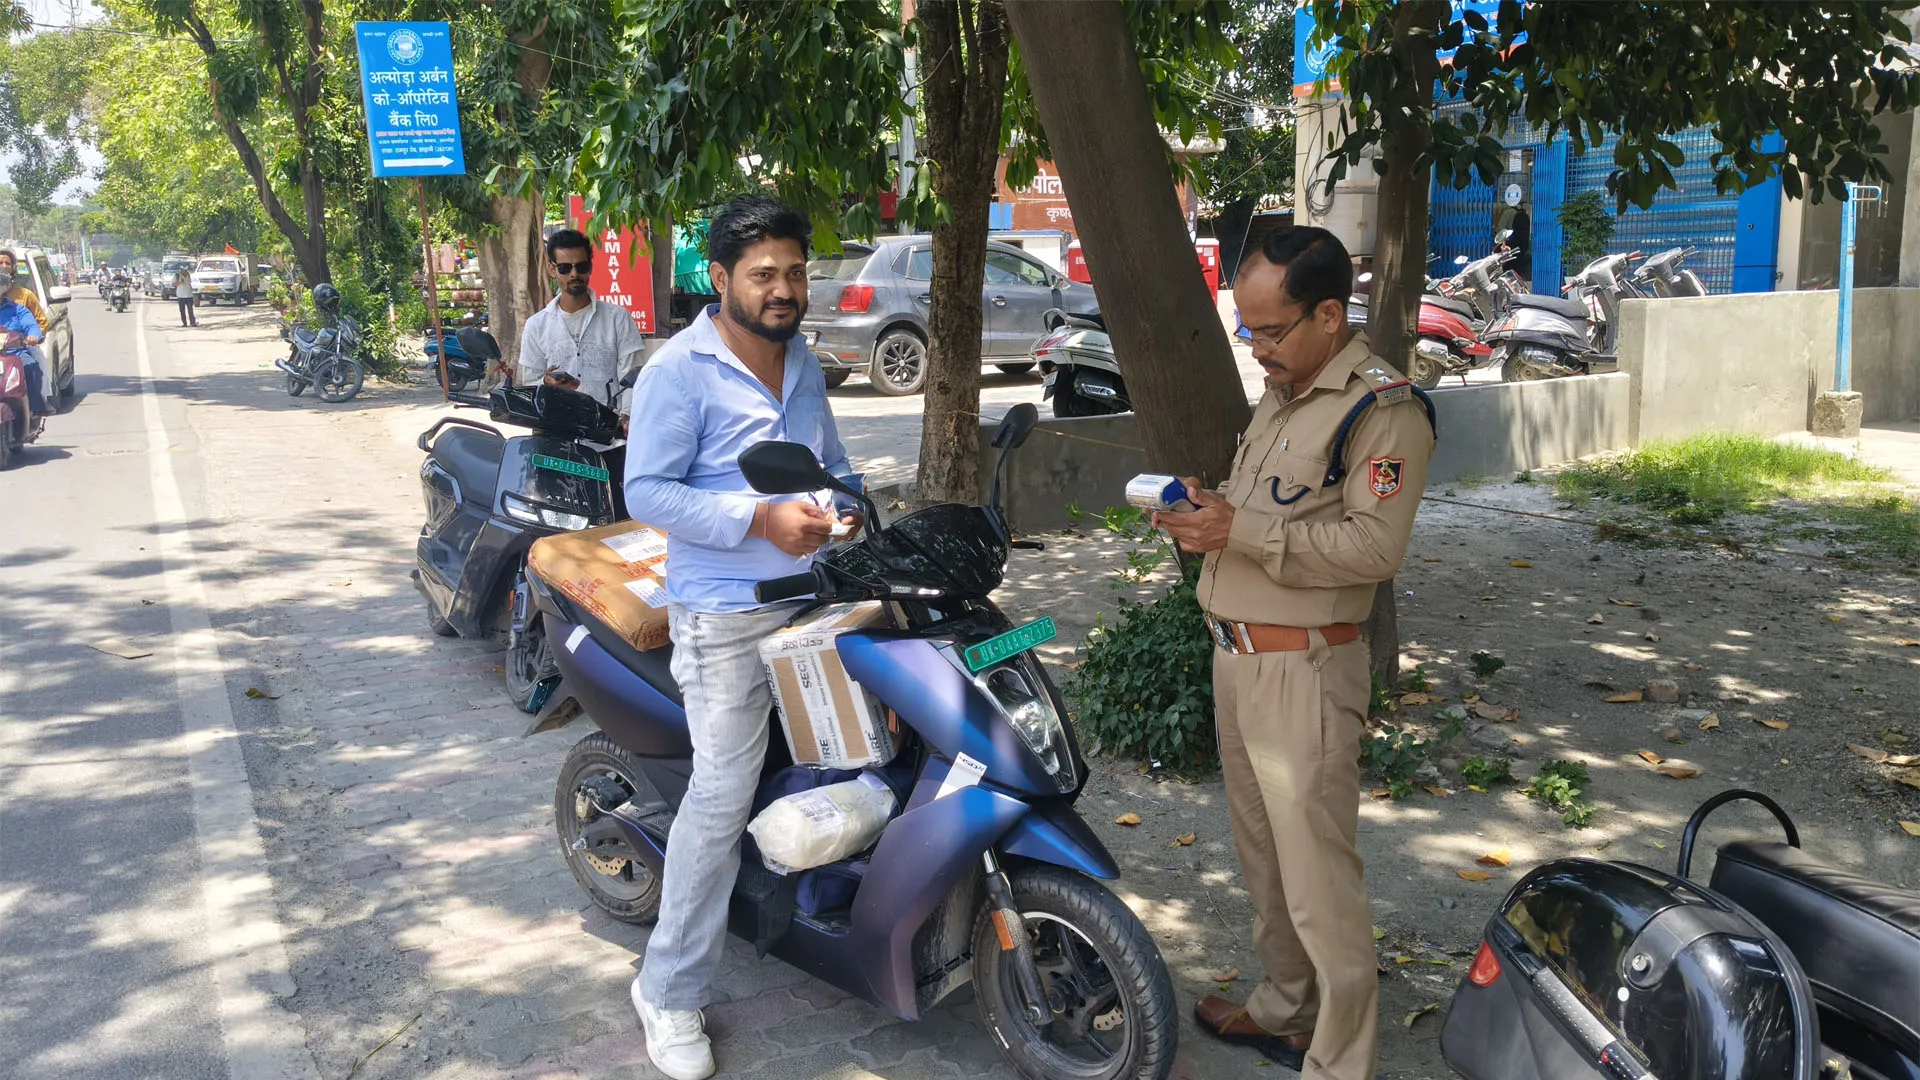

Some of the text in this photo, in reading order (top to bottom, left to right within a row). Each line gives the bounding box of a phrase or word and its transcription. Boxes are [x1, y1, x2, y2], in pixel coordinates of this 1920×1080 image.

[369, 66, 448, 87] अल्मोड़ा अर्बन
[388, 110, 412, 127] बैंक
[599, 294, 632, 306] INN
[629, 310, 646, 319] 404
[635, 321, 647, 330] 12
[546, 494, 588, 506] ATHER
